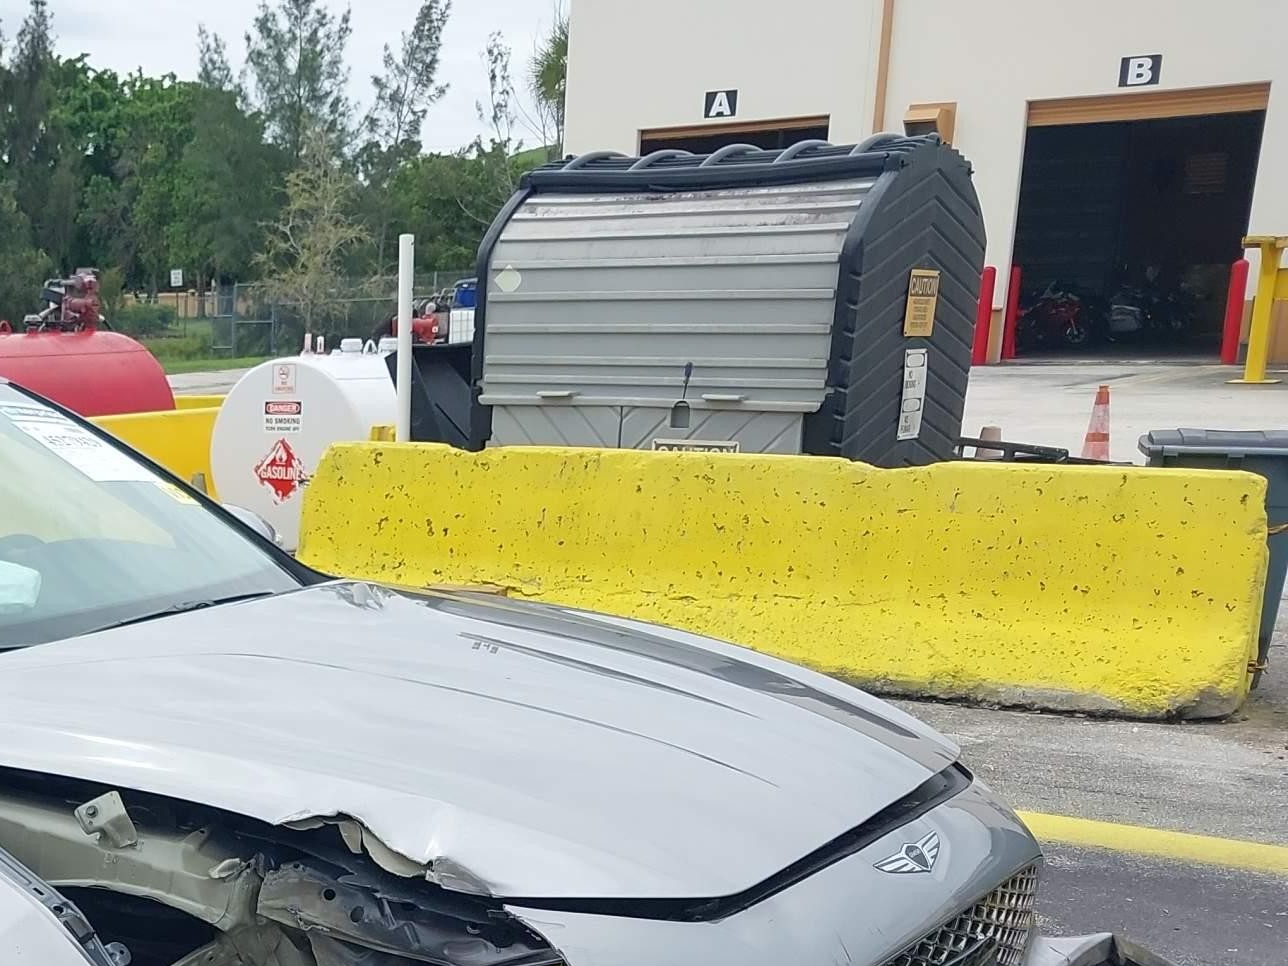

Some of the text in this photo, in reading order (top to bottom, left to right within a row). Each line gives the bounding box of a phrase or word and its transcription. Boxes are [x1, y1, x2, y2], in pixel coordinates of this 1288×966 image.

[1127, 57, 1152, 85] B
[708, 92, 732, 117] A
[911, 277, 937, 295] CAUTION
[261, 465, 301, 480] GASOLINE
